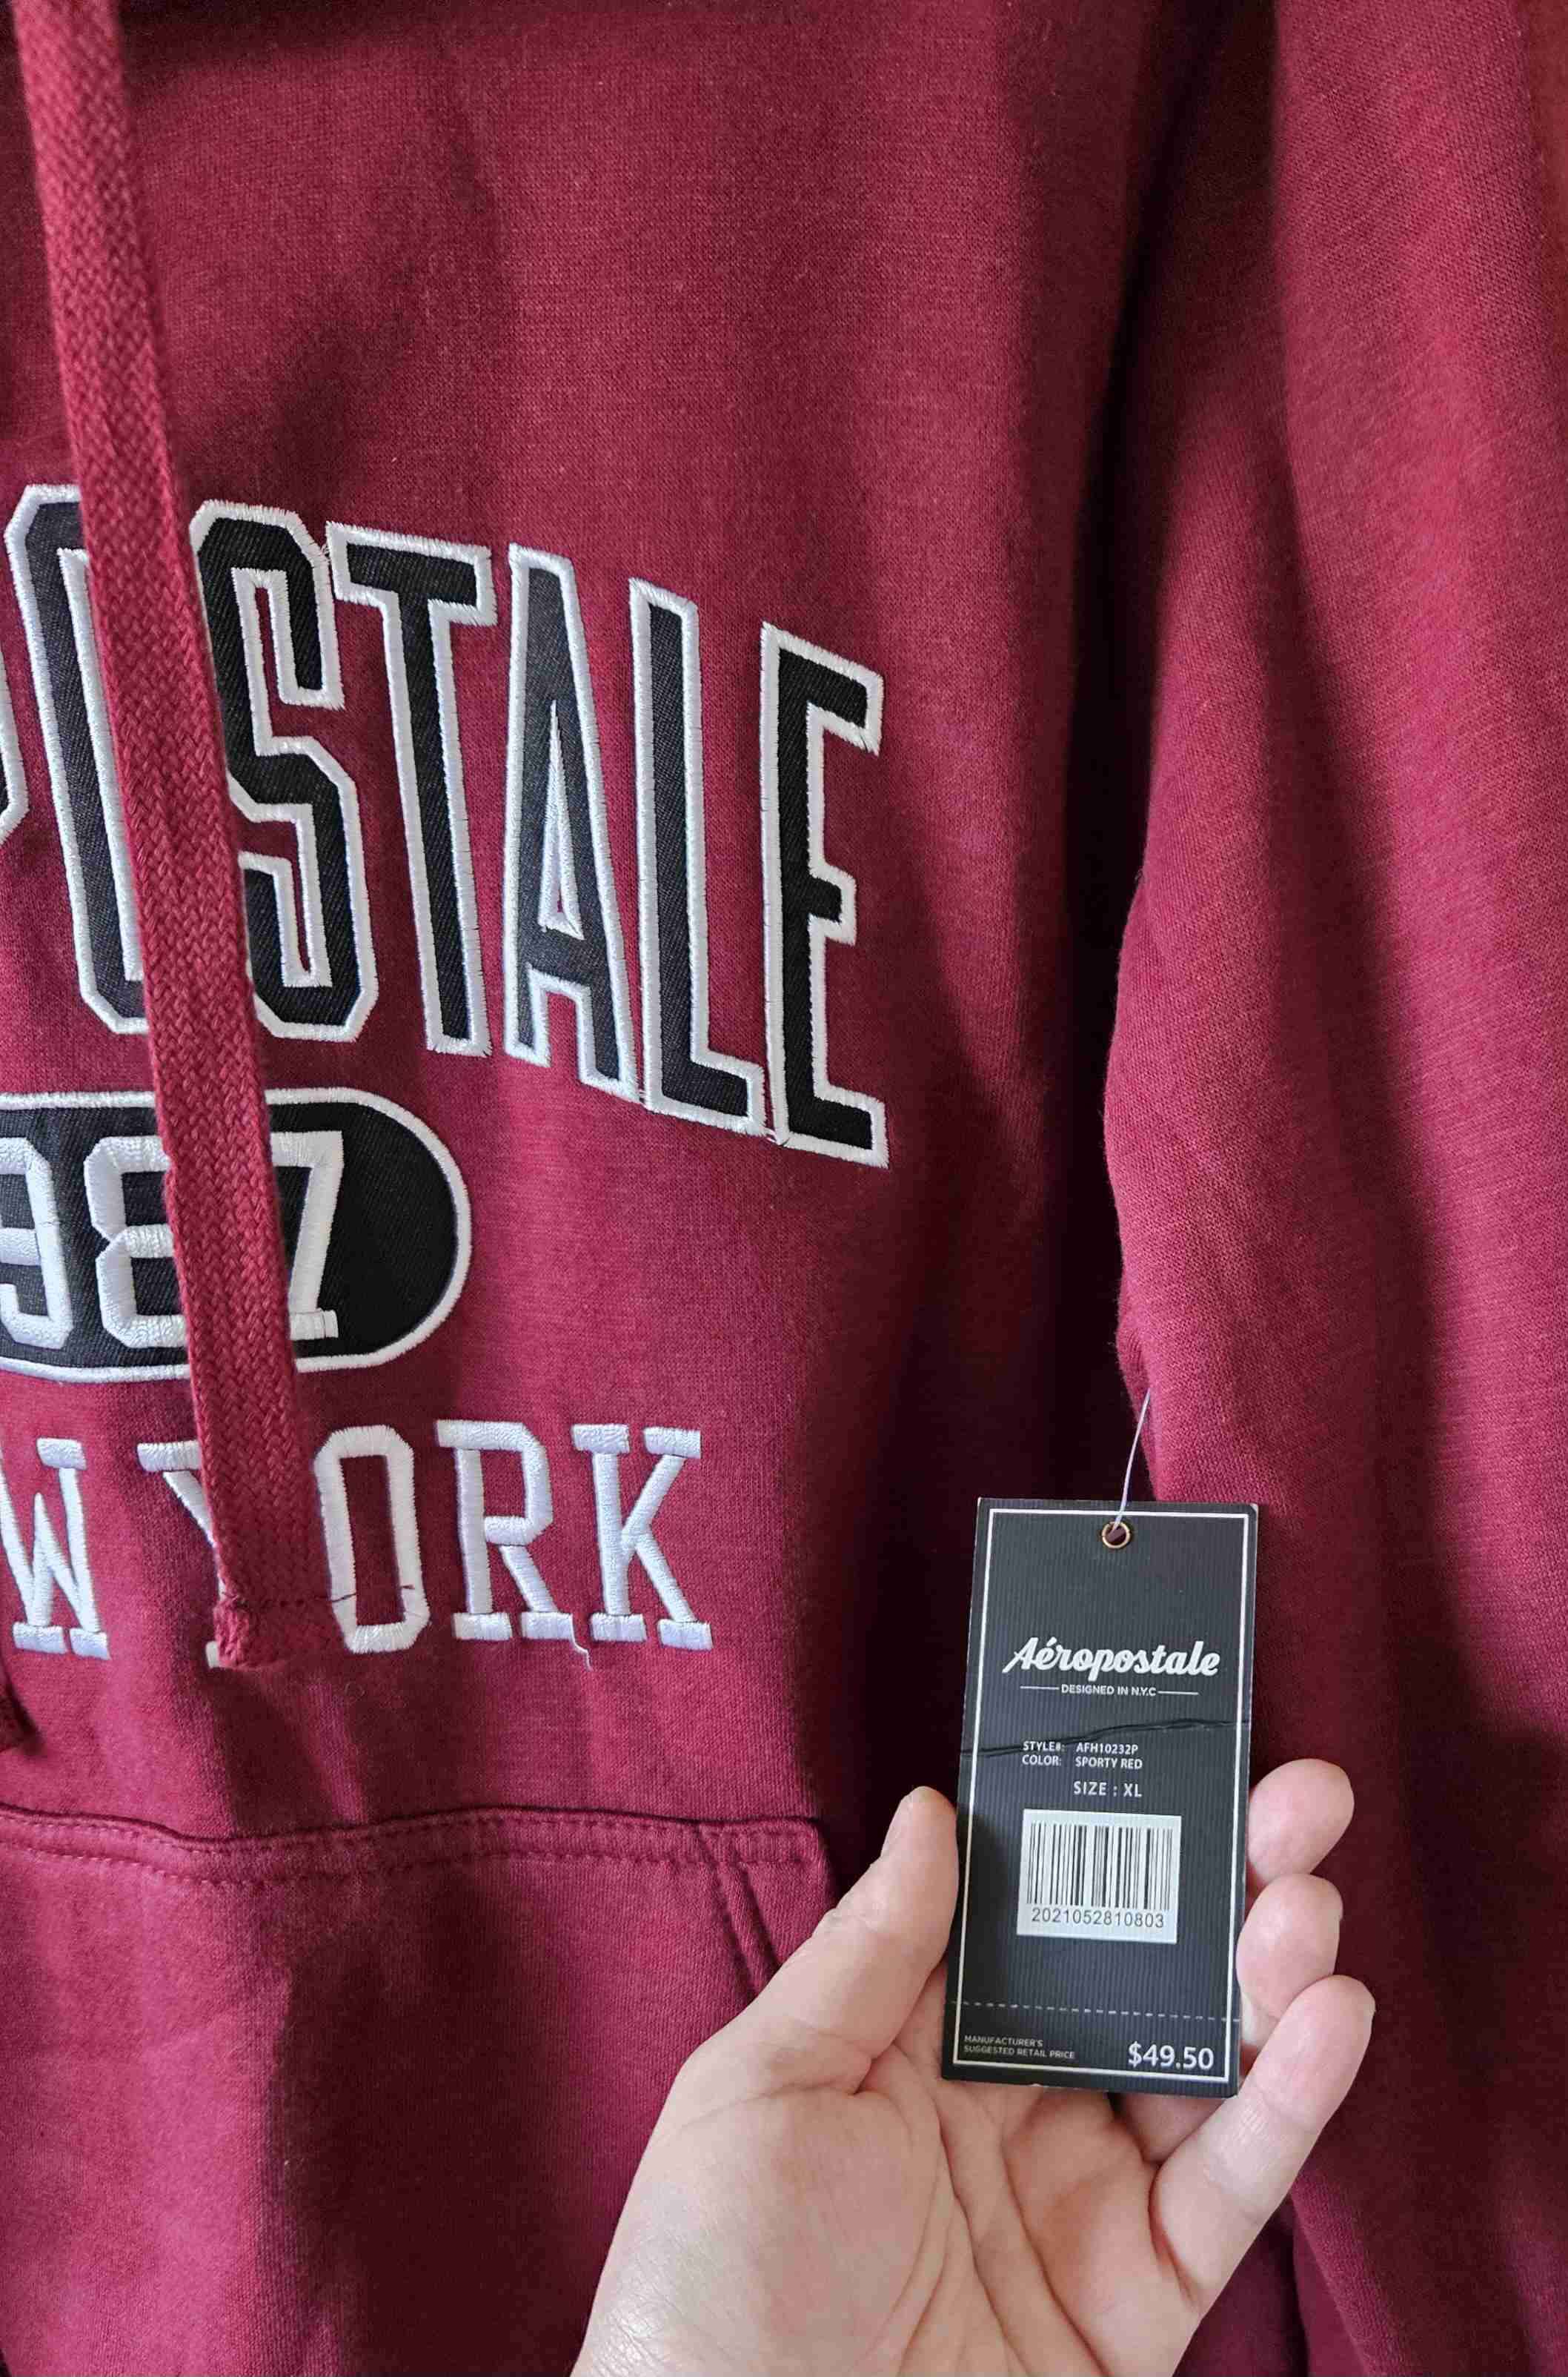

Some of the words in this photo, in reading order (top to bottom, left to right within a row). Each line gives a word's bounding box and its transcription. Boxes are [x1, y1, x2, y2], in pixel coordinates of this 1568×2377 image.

[1002, 1637, 1221, 1682] Aéropostale
[1061, 1683, 1115, 1695] DESIGNED
[1117, 1685, 1129, 1696] IN
[1075, 1742, 1139, 1755] AFH10232P
[1022, 1754, 1062, 1766] COLOR:
[1075, 1756, 1117, 1768] SPORTY
[1120, 1757, 1143, 1770] RED
[1074, 1780, 1107, 1797] SIZE
[1123, 1783, 1143, 1797] XL
[1032, 1907, 1164, 1929] 2021052810803
[964, 2035, 1044, 2048] MANUFACTURER'S
[964, 2044, 1015, 2056] SUGGESTED
[1017, 2047, 1047, 2058] RETAIL
[1049, 2049, 1076, 2060] PRICE
[1128, 2041, 1215, 2070] $49.50
